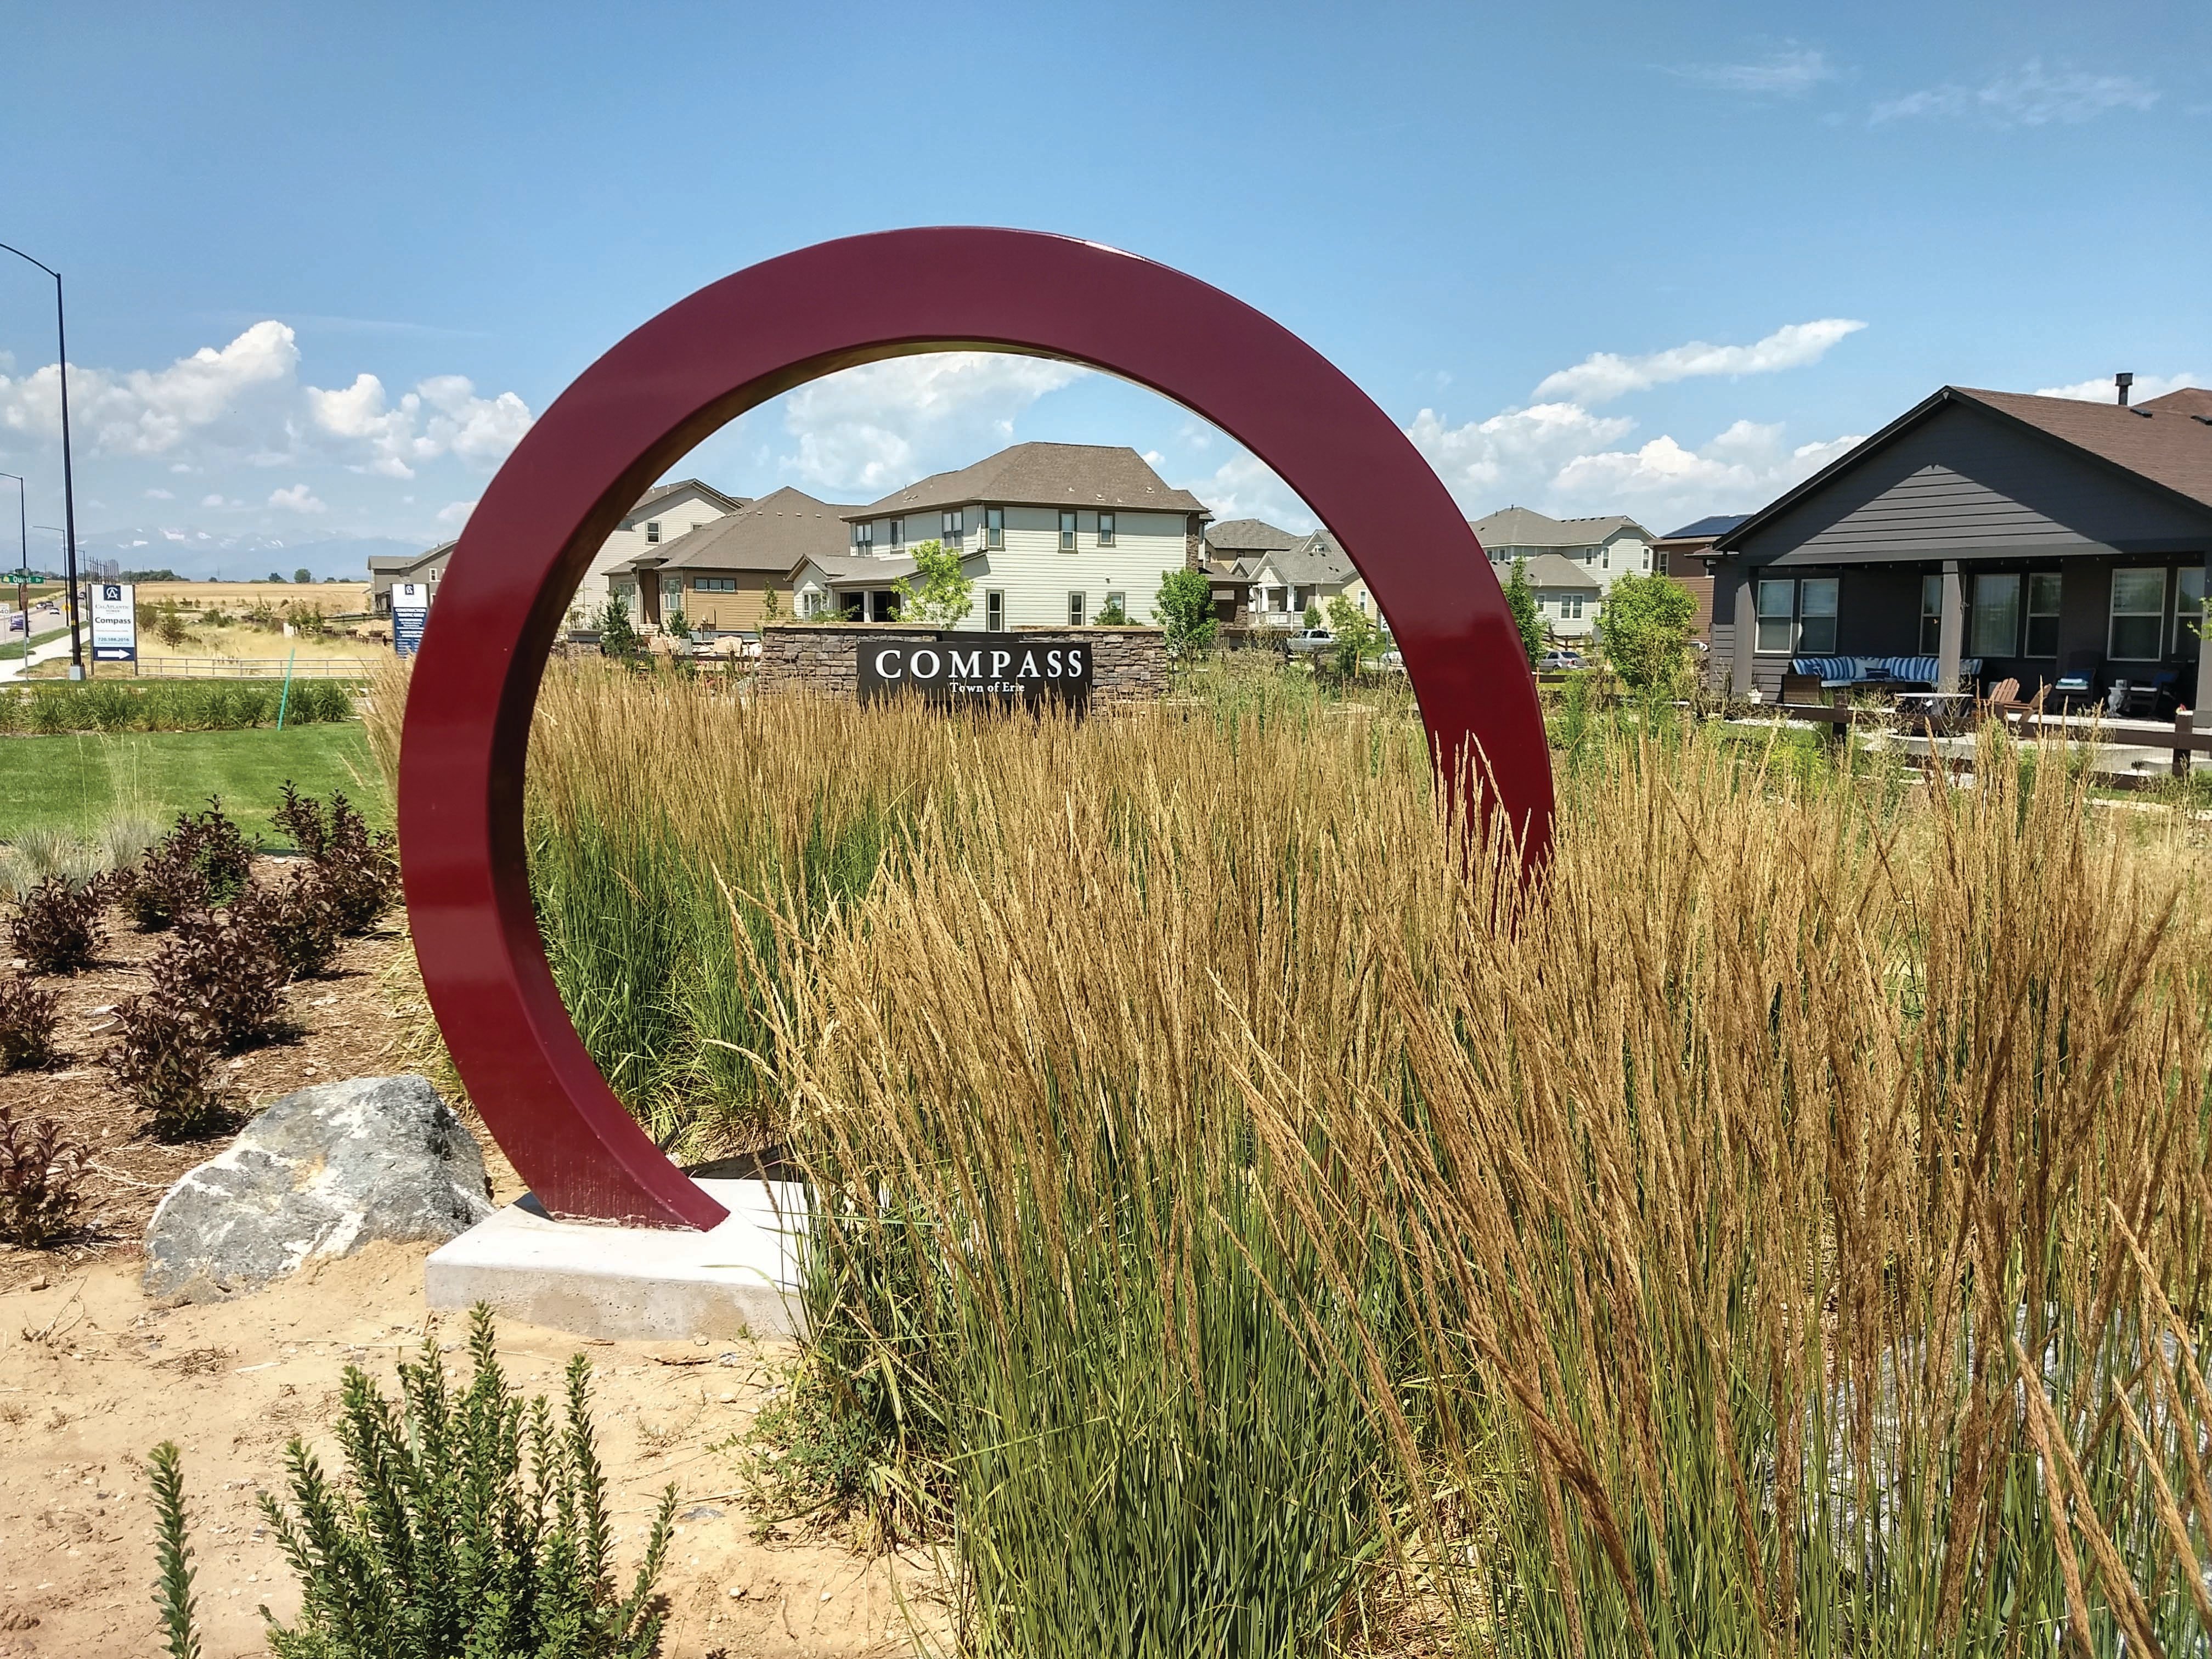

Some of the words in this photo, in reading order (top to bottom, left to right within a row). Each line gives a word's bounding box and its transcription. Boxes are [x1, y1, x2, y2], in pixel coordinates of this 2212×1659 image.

[95, 617, 131, 625] Compass
[875, 650, 1082, 679] COMPASS
[950, 682, 984, 693] Town
[988, 681, 1000, 692] of
